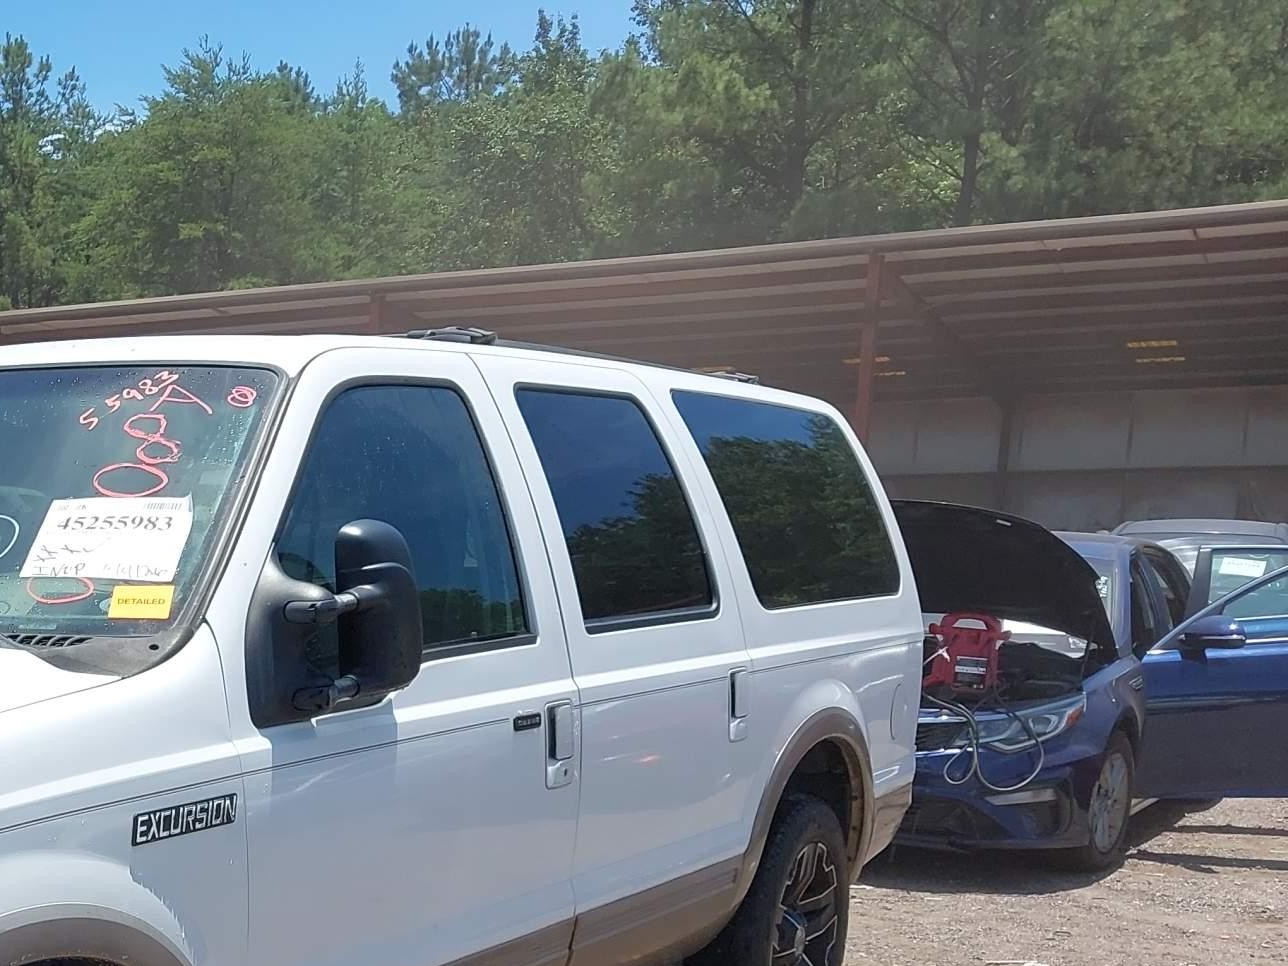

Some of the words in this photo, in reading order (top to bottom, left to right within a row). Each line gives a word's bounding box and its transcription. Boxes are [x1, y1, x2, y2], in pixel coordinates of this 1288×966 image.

[56, 515, 174, 531] 45255983
[117, 597, 166, 605] DETAILED
[135, 795, 238, 844] EXCURSION
